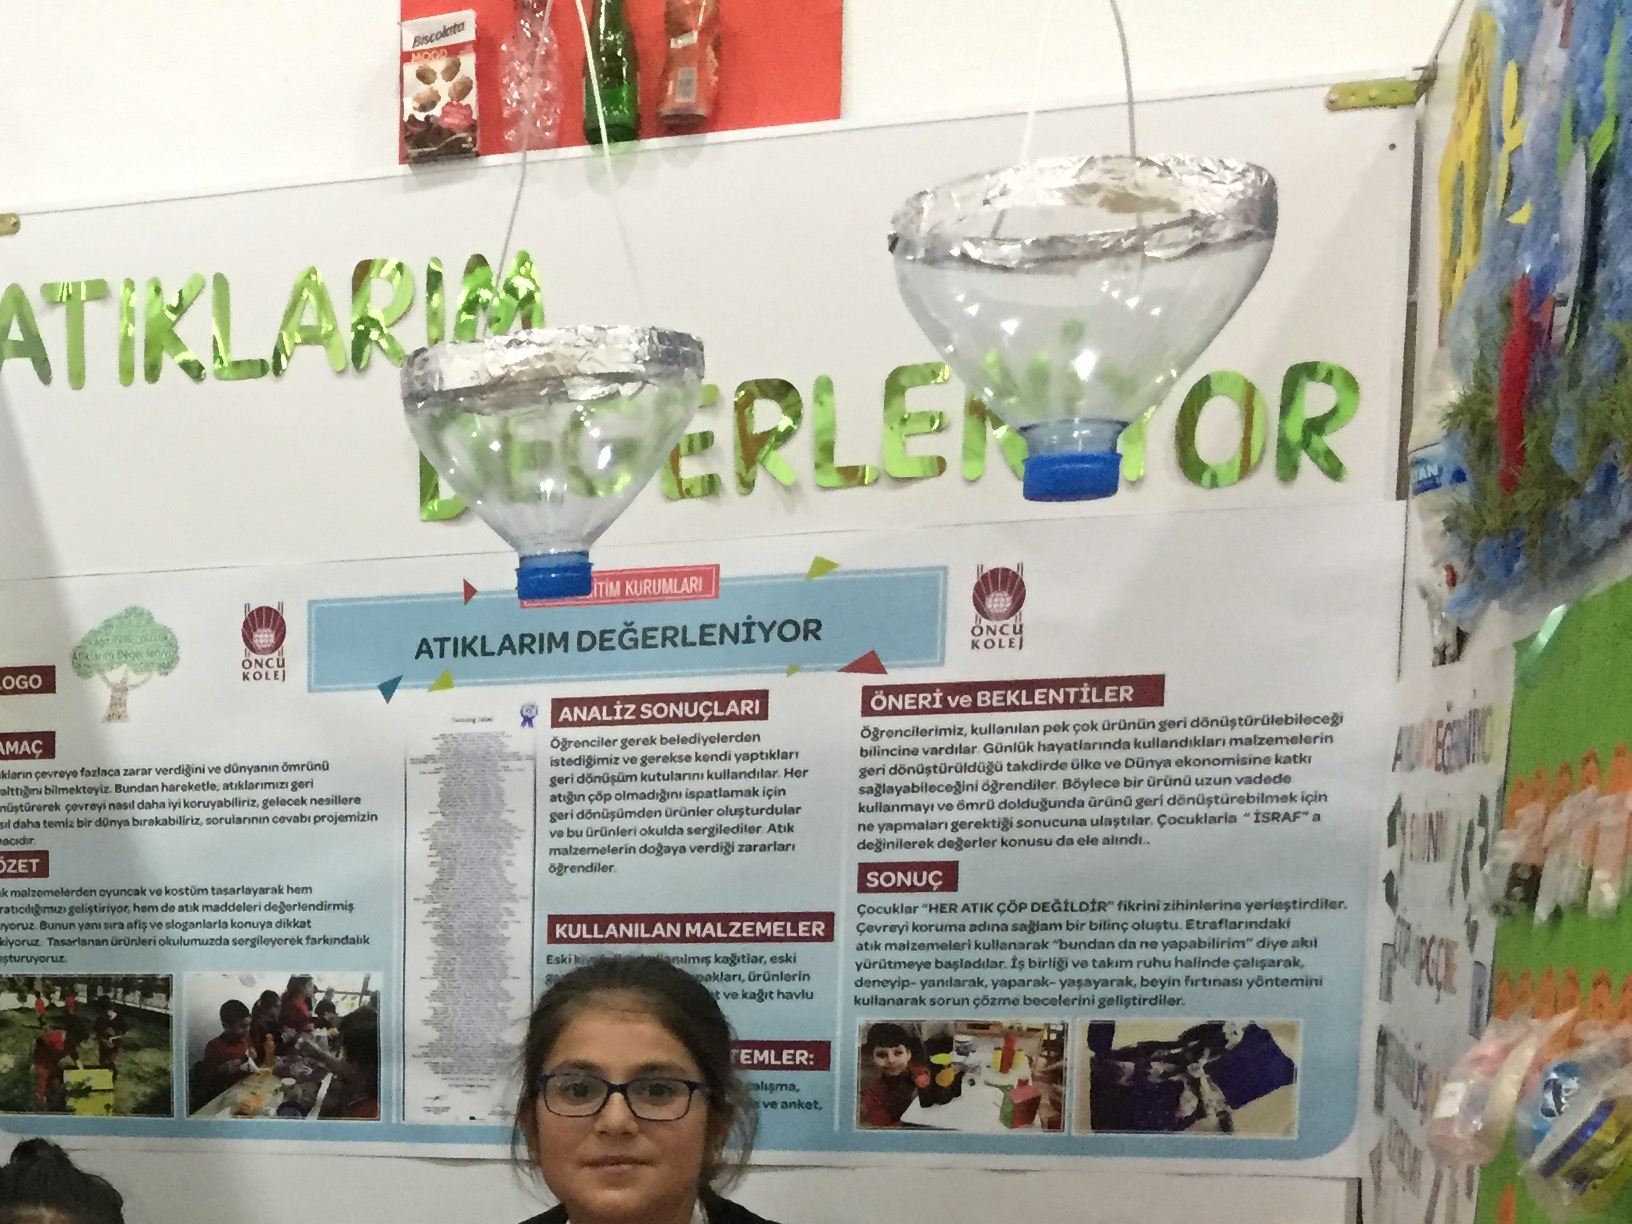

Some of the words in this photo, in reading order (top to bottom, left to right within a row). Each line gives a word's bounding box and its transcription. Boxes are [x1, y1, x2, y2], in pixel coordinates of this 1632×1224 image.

[412, 22, 465, 48] Biscolata
[587, 577, 621, 598] İTİM
[625, 576, 703, 597] KURUMLARI
[414, 631, 570, 660] ATIKLARIM
[577, 614, 823, 653] DEĞERLENİYOR
[970, 636, 1023, 651] KOLEJ
[241, 670, 286, 682] KOLEJ
[870, 689, 943, 711] ÖNERİ
[947, 694, 973, 708] ve
[976, 683, 1135, 707] BEKLENTİLER
[558, 701, 636, 722] ANALİZ
[640, 699, 760, 721] SONUÇLARI
[550, 736, 618, 752] Öğrenciler
[621, 736, 656, 750] gerek
[660, 732, 760, 745] belediyelerden
[550, 754, 619, 769] istediğimiz
[623, 756, 637, 764] ve
[640, 752, 692, 768] gerekse
[695, 751, 731, 762] kendi
[734, 749, 799, 763] yaptıkları
[549, 774, 574, 788] geri
[577, 771, 638, 785] dönüşüm
[641, 771, 704, 782] kutularını
[784, 767, 808, 779] Her
[550, 791, 585, 806] atığın
[588, 790, 612, 804] çöp
[615, 789, 682, 803] olmadığını
[685, 787, 759, 800] ispatlamak
[763, 786, 786, 799] için
[550, 808, 574, 823] geri
[576, 807, 662, 820] dönüşümden
[665, 806, 714, 818] ürünler
[717, 804, 801, 818] oluşturdular
[550, 830, 564, 838] ve
[567, 827, 583, 838] bu
[586, 825, 637, 837] ürünleri
[639, 825, 684, 836] okulda
[767, 823, 794, 833] Atık
[866, 869, 943, 890] SONUÇ
[857, 903, 918, 916] Çocuklar
[961, 903, 993, 913] ATIK
[997, 899, 1027, 915] ÇÖP
[1117, 900, 1160, 911] fikrini
[1163, 900, 1241, 911] zihinlerine
[1245, 898, 1347, 912] yerleştirdiler.
[555, 923, 681, 940] KULLANILAN
[685, 921, 826, 937] MALZEMELER
